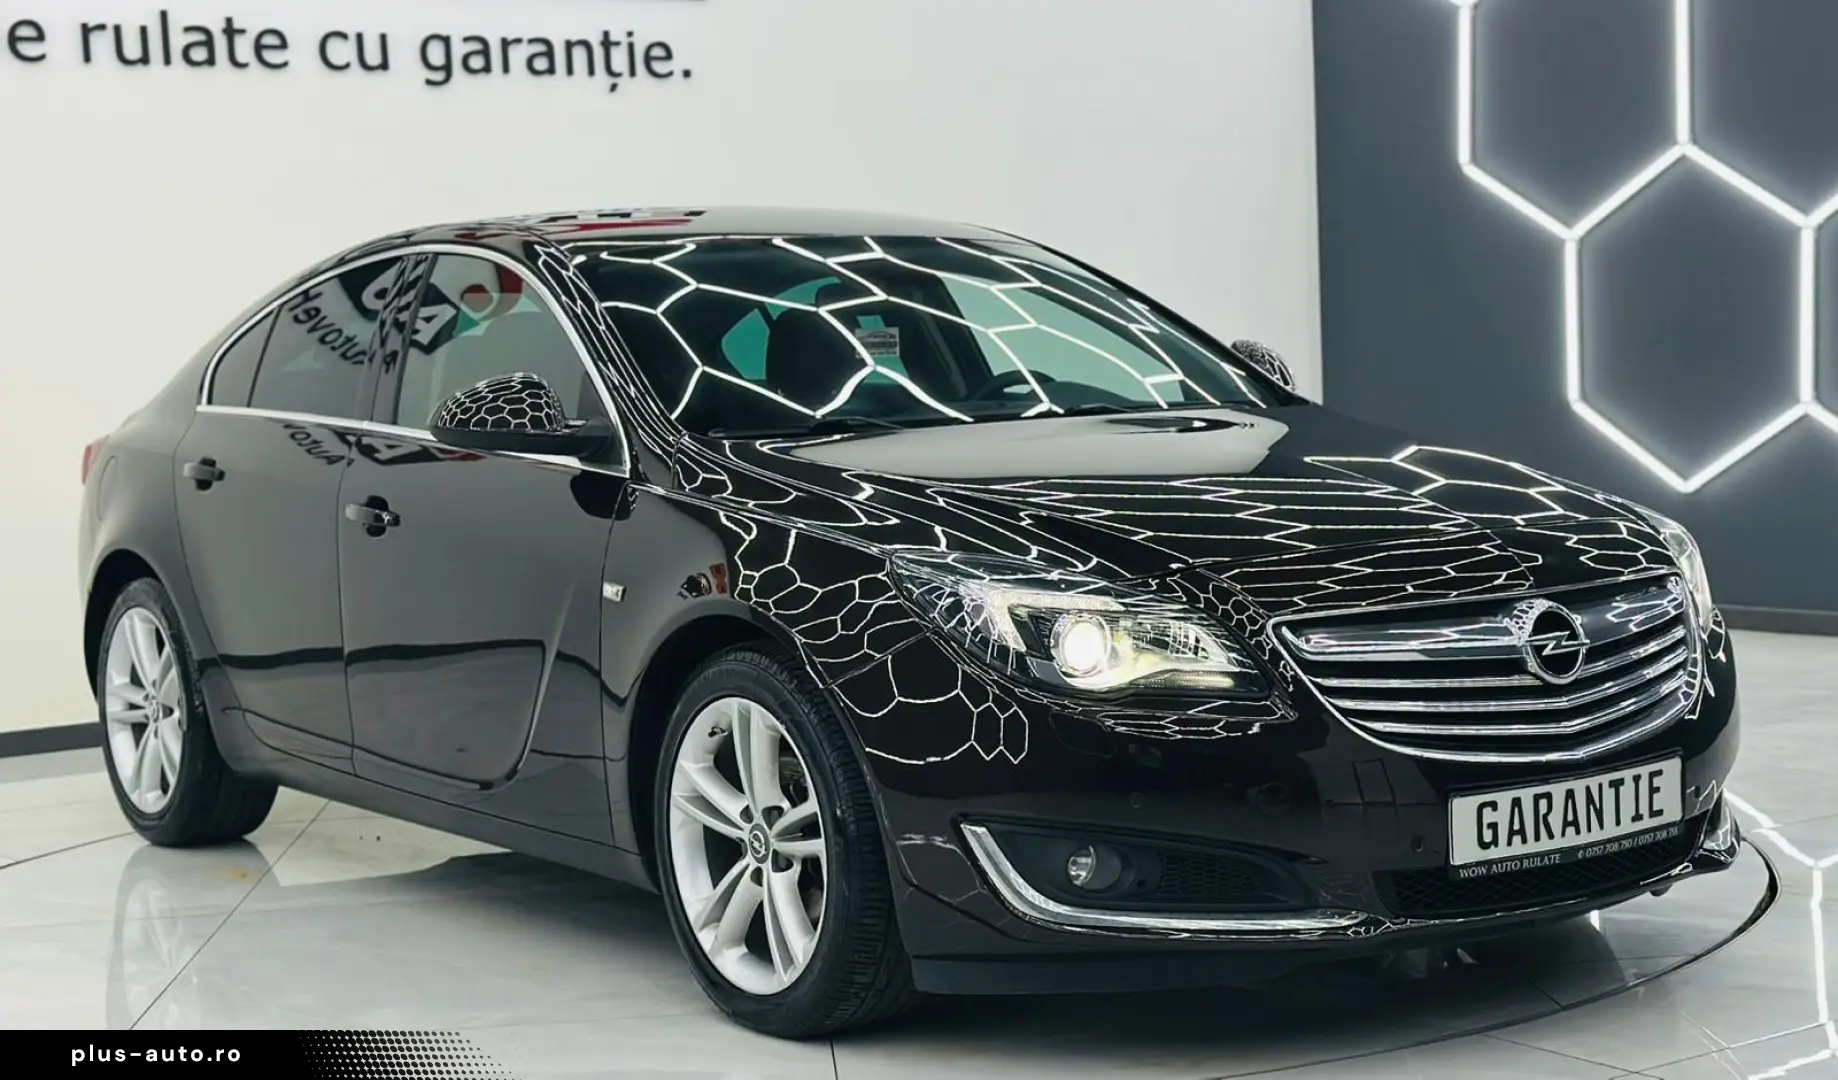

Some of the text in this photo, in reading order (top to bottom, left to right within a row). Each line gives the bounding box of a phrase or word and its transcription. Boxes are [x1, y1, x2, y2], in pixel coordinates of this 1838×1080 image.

[6, 10, 693, 92] e rulate cu garanție.
[1475, 769, 1664, 850] GARANTIE
[1460, 854, 1561, 878] WOW AUTO RULATE
